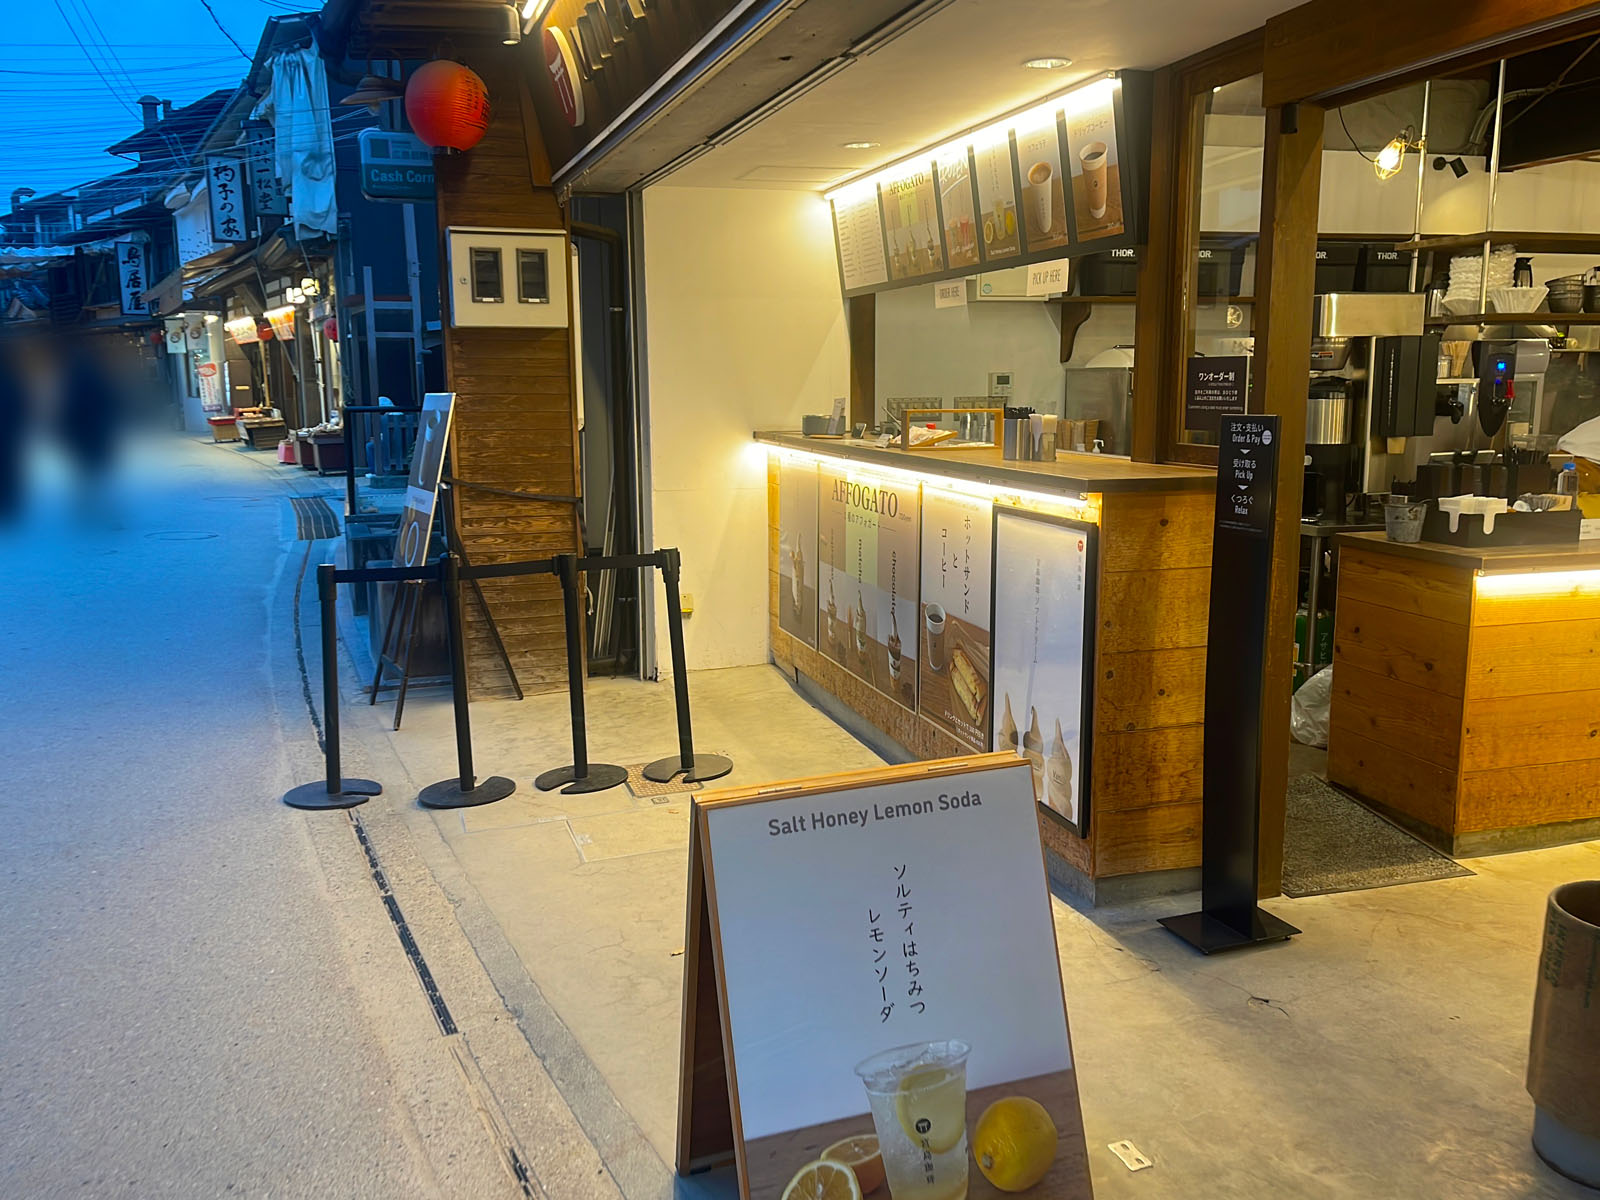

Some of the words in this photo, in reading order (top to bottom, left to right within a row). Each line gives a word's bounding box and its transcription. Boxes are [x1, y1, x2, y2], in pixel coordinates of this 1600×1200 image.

[371, 169, 403, 183] Cash
[406, 169, 434, 183] Corn
[889, 172, 924, 196] AFFOGATO
[213, 161, 240, 238] 杓子の家
[1032, 271, 1042, 285] PICK
[1042, 271, 1049, 284] UP
[1050, 268, 1061, 282] HERE
[1199, 371, 1235, 381] ワンオーダー制
[1230, 422, 1264, 432] 注文・支払い
[1232, 433, 1246, 443] Order
[1246, 434, 1251, 443] &
[1251, 434, 1261, 445] Pay
[1232, 458, 1257, 469] 受け取る
[1235, 469, 1246, 479] Pick
[1246, 471, 1253, 481] Up
[832, 479, 898, 518] AFFOGATO
[1231, 494, 1254, 505] くつろぐ
[1234, 505, 1248, 515] Relax
[953, 553, 958, 568] と
[768, 815, 806, 837] Salt
[811, 806, 869, 832] Honey
[873, 797, 934, 822] Lemon
[938, 790, 982, 812] Soda
[893, 863, 926, 1016] ソルティはちみつ
[867, 908, 895, 1025] レモンソーダ
